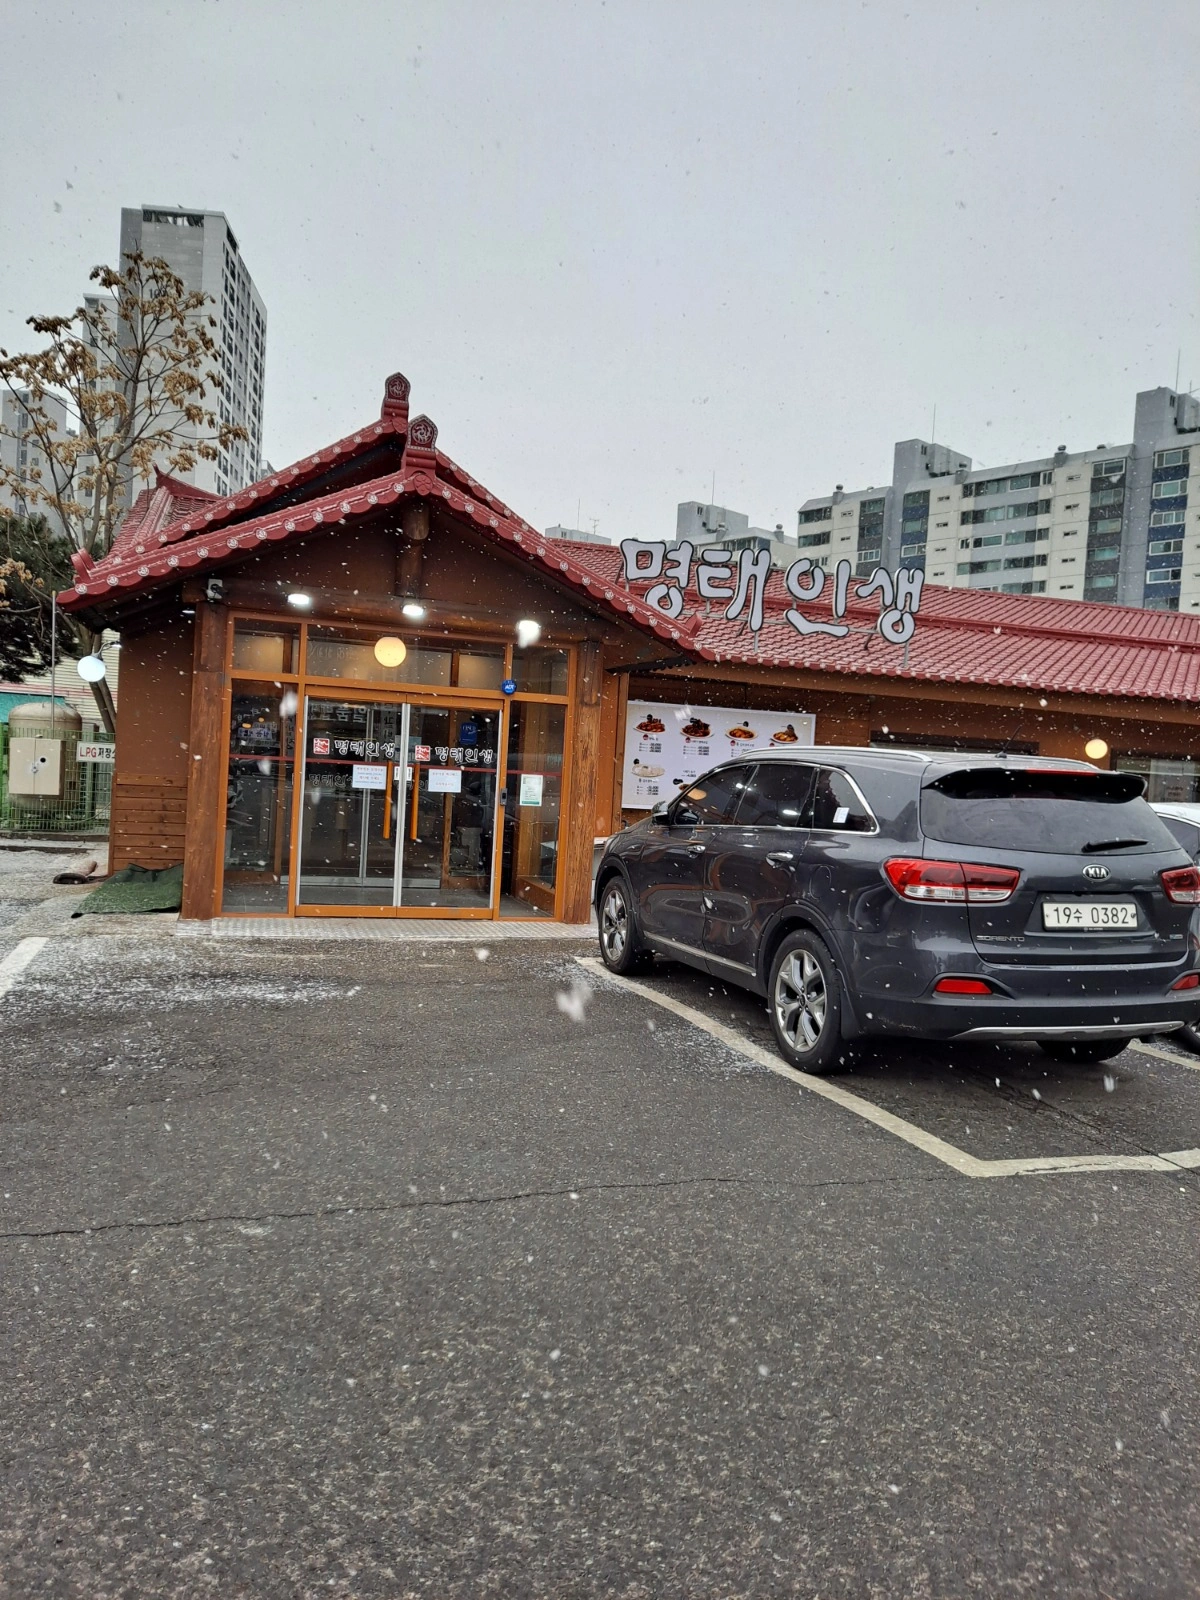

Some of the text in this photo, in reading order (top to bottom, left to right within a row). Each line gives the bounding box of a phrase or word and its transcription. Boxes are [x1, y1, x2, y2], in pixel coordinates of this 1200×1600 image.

[334, 739, 396, 758] 명태인생
[435, 746, 494, 764] 명태인생
[1087, 866, 1107, 878] KIA
[1053, 906, 1130, 925] 19수 0382
